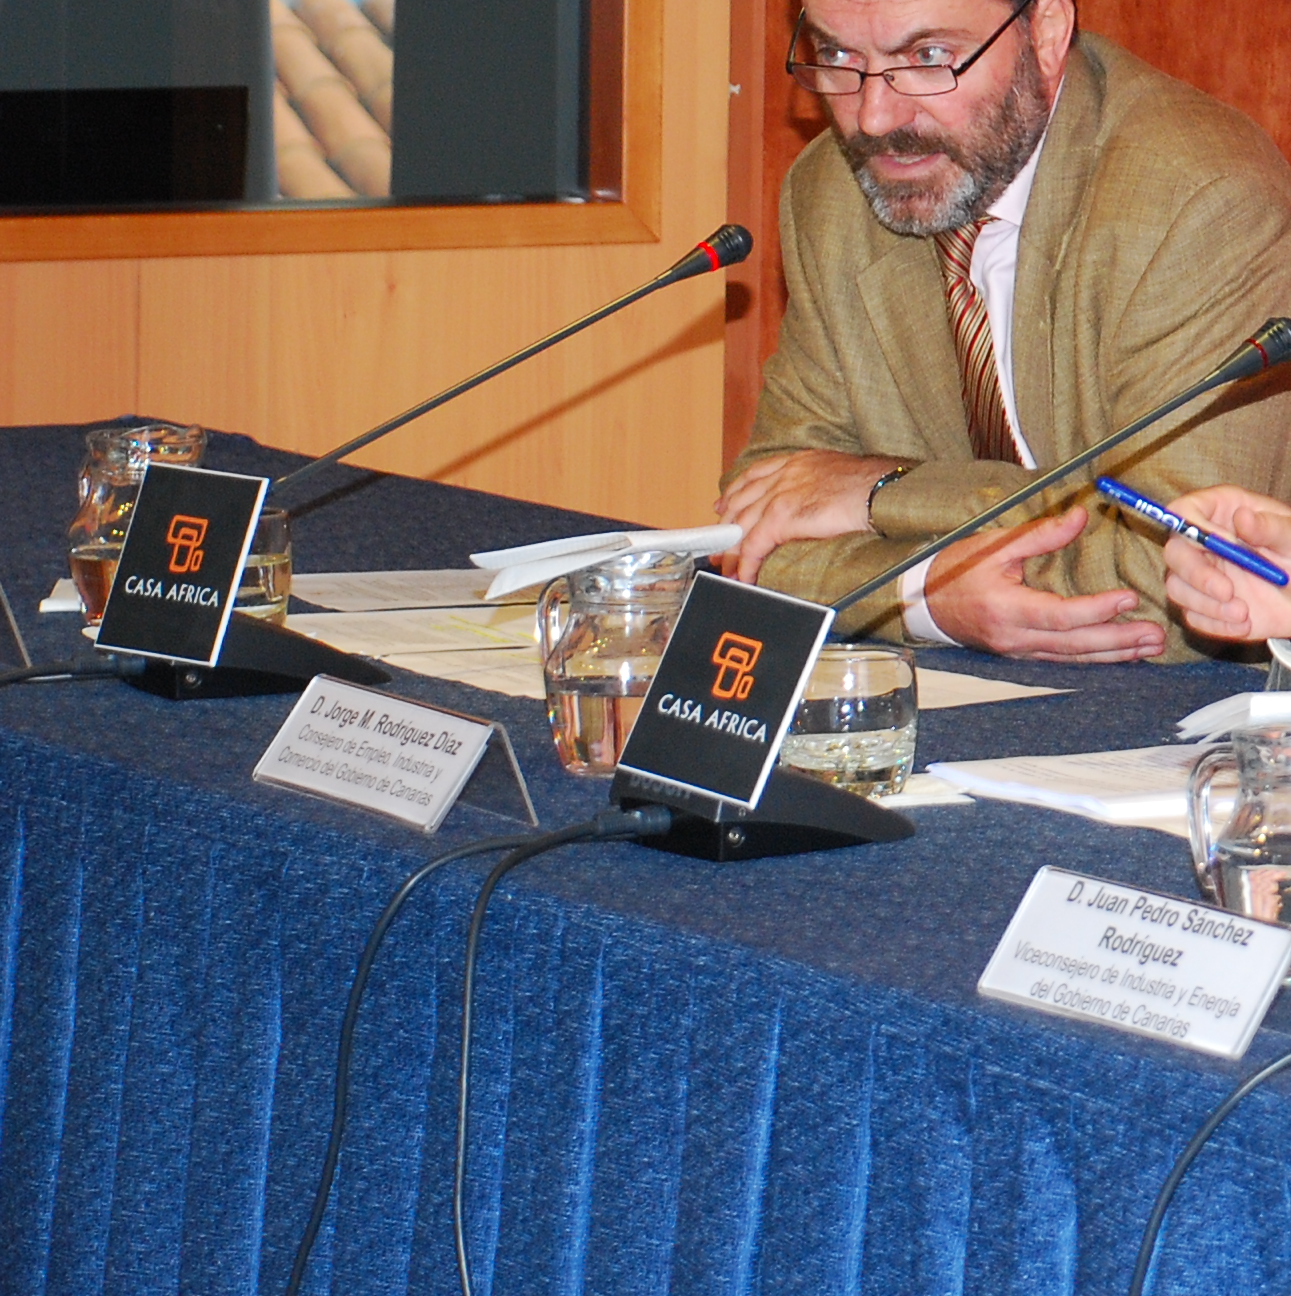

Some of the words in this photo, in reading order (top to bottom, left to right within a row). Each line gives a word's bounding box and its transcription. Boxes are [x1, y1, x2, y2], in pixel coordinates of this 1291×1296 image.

[125, 575, 162, 598] CASA
[166, 583, 219, 607] AFRICA
[310, 695, 326, 716] D.
[324, 700, 359, 728] Jorge
[358, 709, 376, 730] M.
[373, 713, 435, 746] Rodríguez
[433, 731, 463, 756] Díaz
[657, 693, 702, 723] CASA
[704, 709, 767, 743] AFRICA
[278, 745, 322, 772] Comercio
[320, 760, 338, 777] del
[335, 762, 377, 789] Gobierno
[375, 775, 391, 793] de
[389, 779, 434, 806] Canarias
[298, 723, 344, 752] Consejero
[342, 738, 357, 755] de
[392, 752, 435, 778] Industria
[431, 767, 443, 784] y
[1066, 880, 1085, 904] D.
[1086, 887, 1129, 915] Juan
[1129, 896, 1180, 928] Pedro
[1181, 908, 1255, 947] Sánchez
[1097, 926, 1185, 967] Rodríguez
[1013, 939, 1101, 980] Viceconsejero
[1101, 964, 1120, 985] de
[1120, 968, 1177, 1000] Industria
[1174, 987, 1188, 1007] y
[1187, 986, 1242, 1019] Energía
[1030, 978, 1052, 999] del
[1052, 983, 1111, 1019] Gobierno
[1111, 999, 1131, 1021] de
[1130, 1003, 1192, 1039] Canarias
